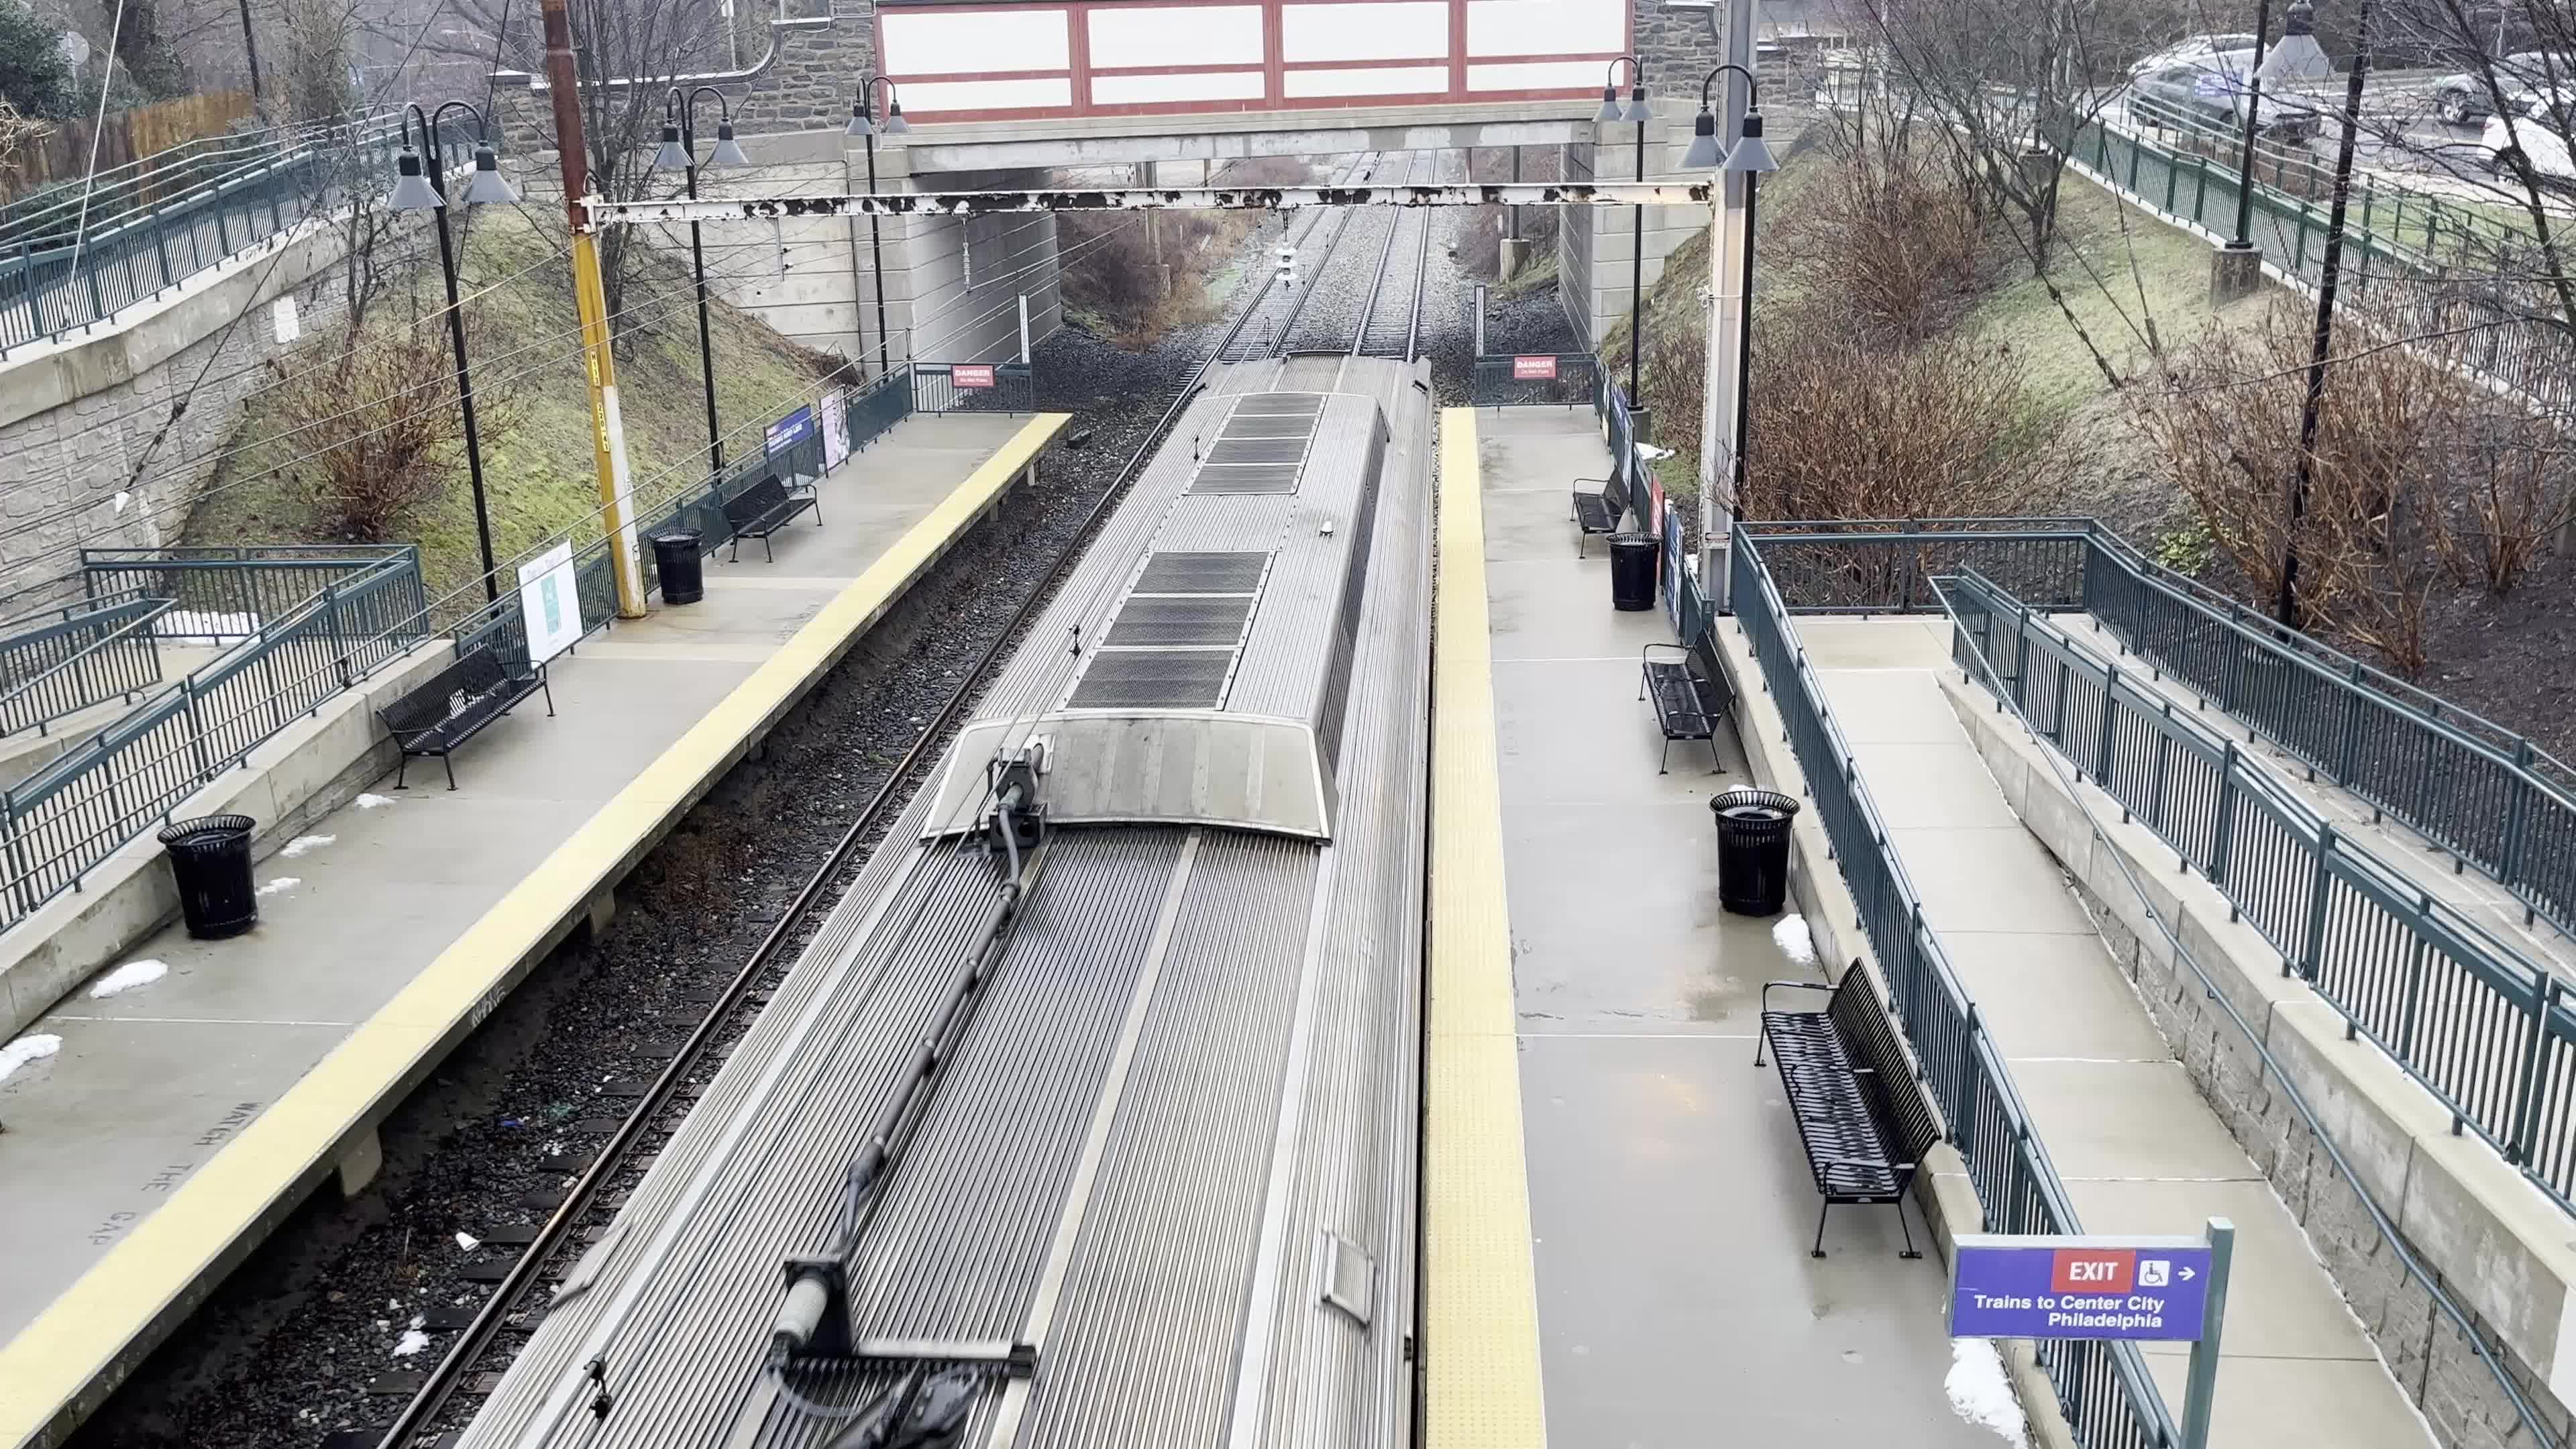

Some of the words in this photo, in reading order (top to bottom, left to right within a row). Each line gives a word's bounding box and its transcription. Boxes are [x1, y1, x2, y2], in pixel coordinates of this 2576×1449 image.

[1517, 360, 1552, 368] DANGER
[197, 1102, 262, 1146] WATCH
[140, 1163, 193, 1191] THE
[88, 1212, 136, 1246] GAP
[2069, 1262, 2118, 1281] EXIT
[1974, 1295, 2031, 1309] Trains
[2038, 1296, 2055, 1309] to
[2060, 1295, 2122, 1310] Center
[2128, 1296, 2164, 1313] City
[2048, 1313, 2162, 1330] Philadelphia
